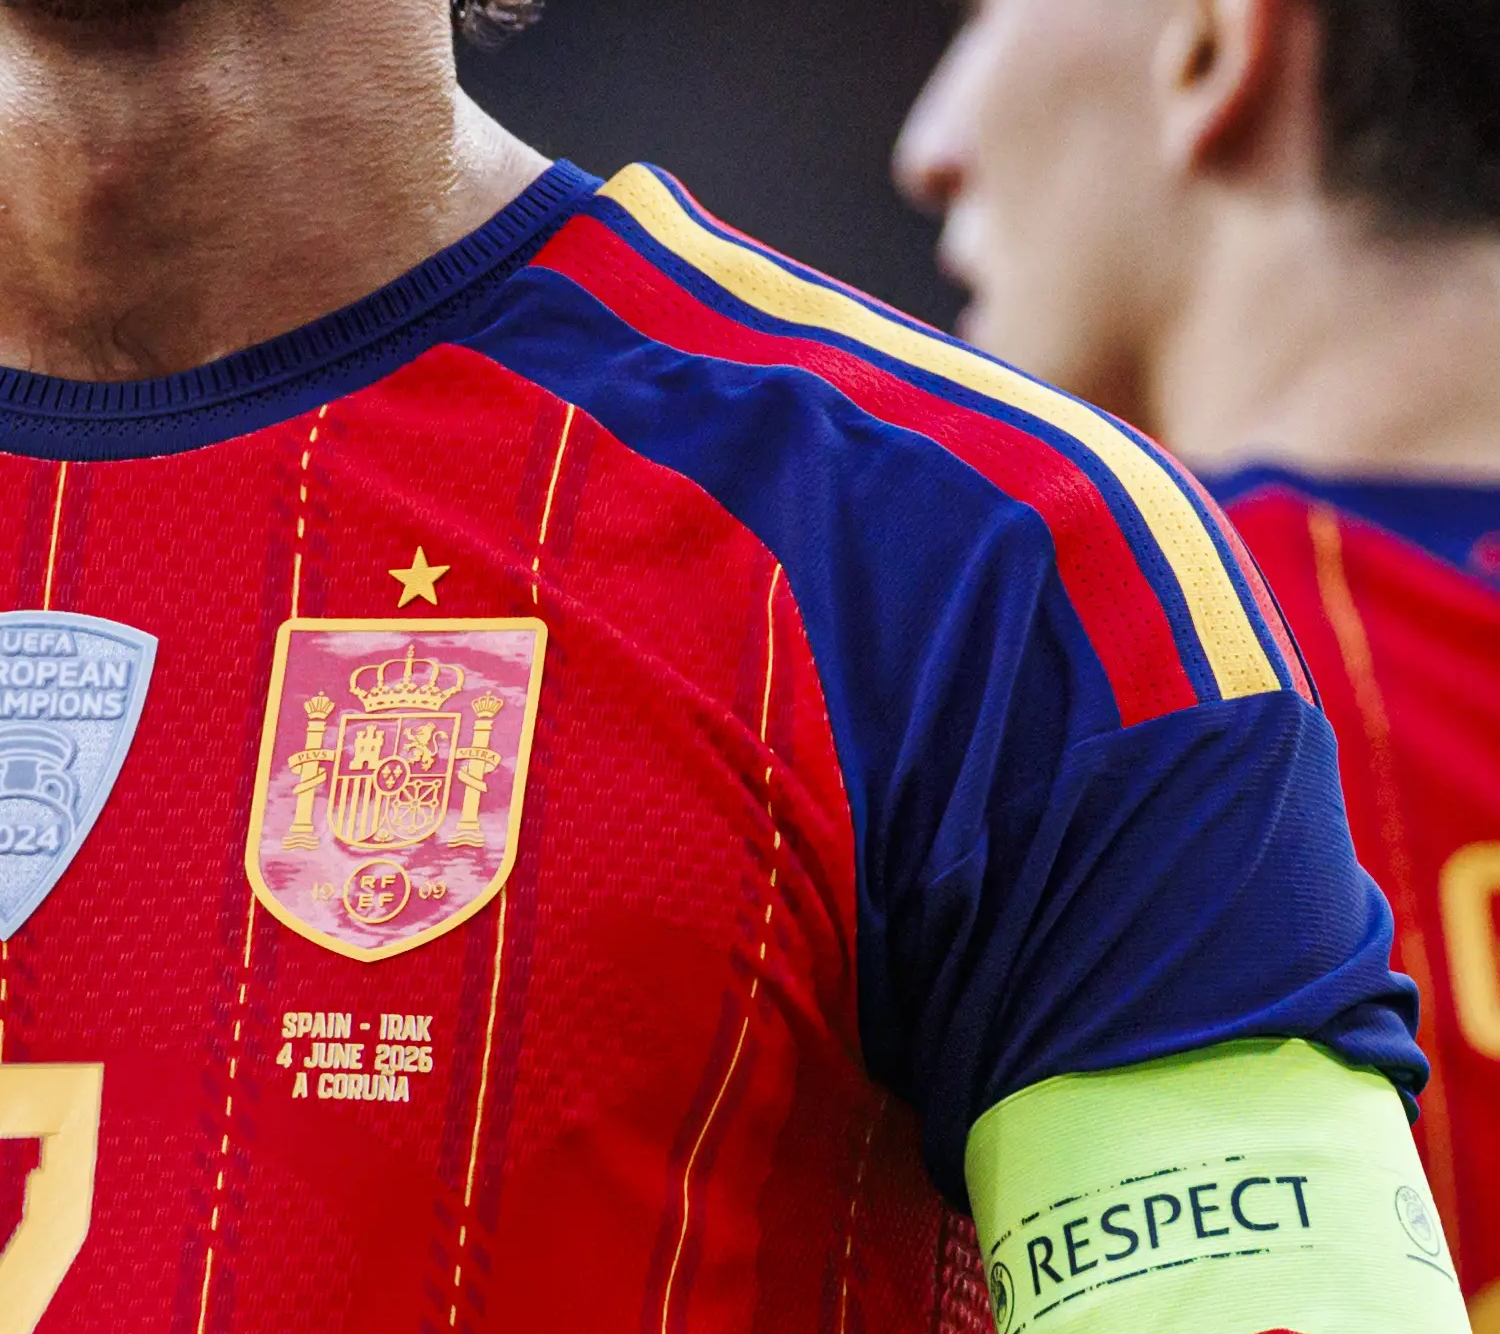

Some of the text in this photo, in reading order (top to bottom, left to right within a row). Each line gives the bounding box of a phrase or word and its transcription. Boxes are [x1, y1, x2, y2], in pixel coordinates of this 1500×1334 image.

[2, 630, 73, 653] UEFA
[281, 1012, 352, 1039] SPAIN
[379, 1013, 433, 1042] IRAK
[276, 1042, 434, 1073] 4 JUNE 2026
[291, 1069, 410, 1102] A CORUÑA
[1026, 1175, 1312, 1297] RESPECT
